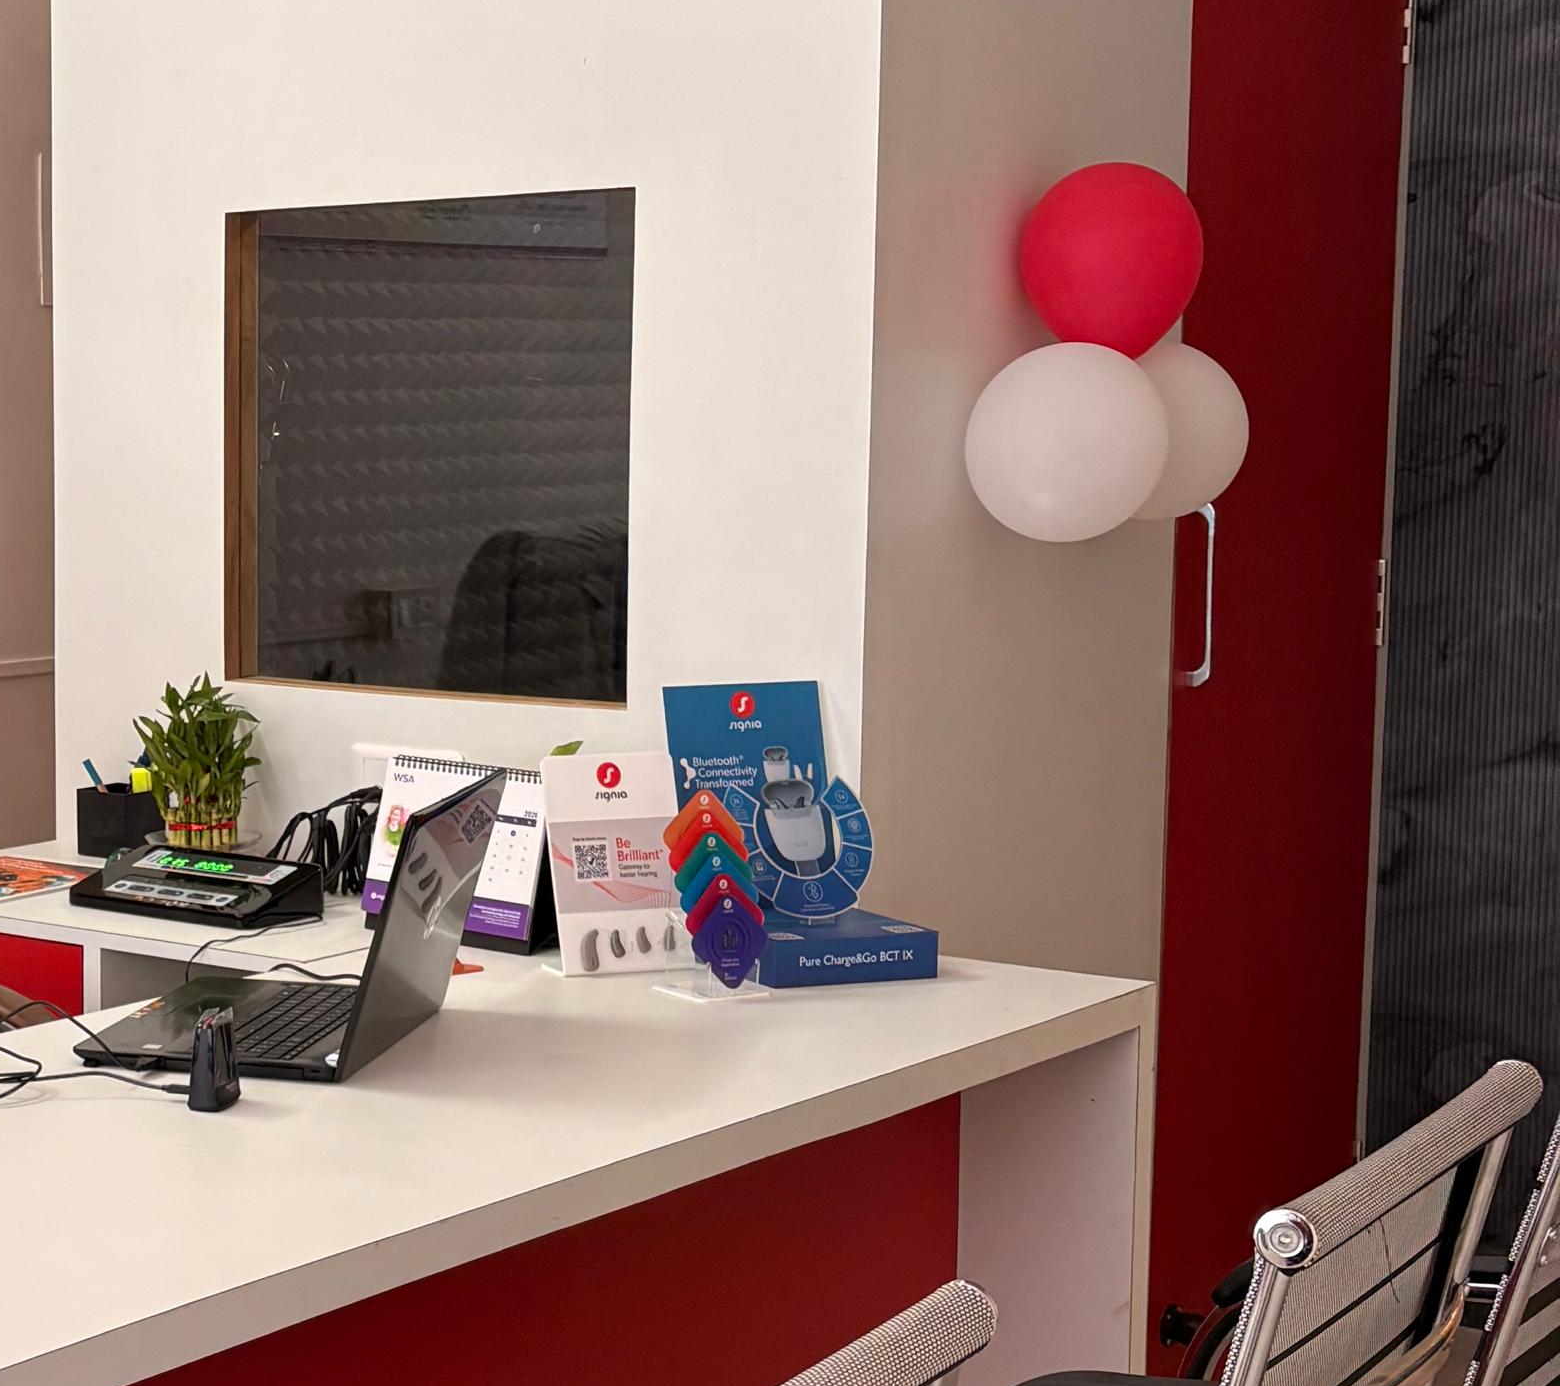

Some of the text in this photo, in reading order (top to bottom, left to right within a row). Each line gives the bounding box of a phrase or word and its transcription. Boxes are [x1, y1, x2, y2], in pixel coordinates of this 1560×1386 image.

[729, 720, 762, 732] signia
[698, 766, 758, 778] Connectivity
[393, 773, 415, 784] WSA
[695, 778, 754, 789] Transformed
[595, 791, 628, 802] signia
[616, 837, 631, 849] Be
[799, 949, 914, 967] Pure Charge&Go BCT IX
